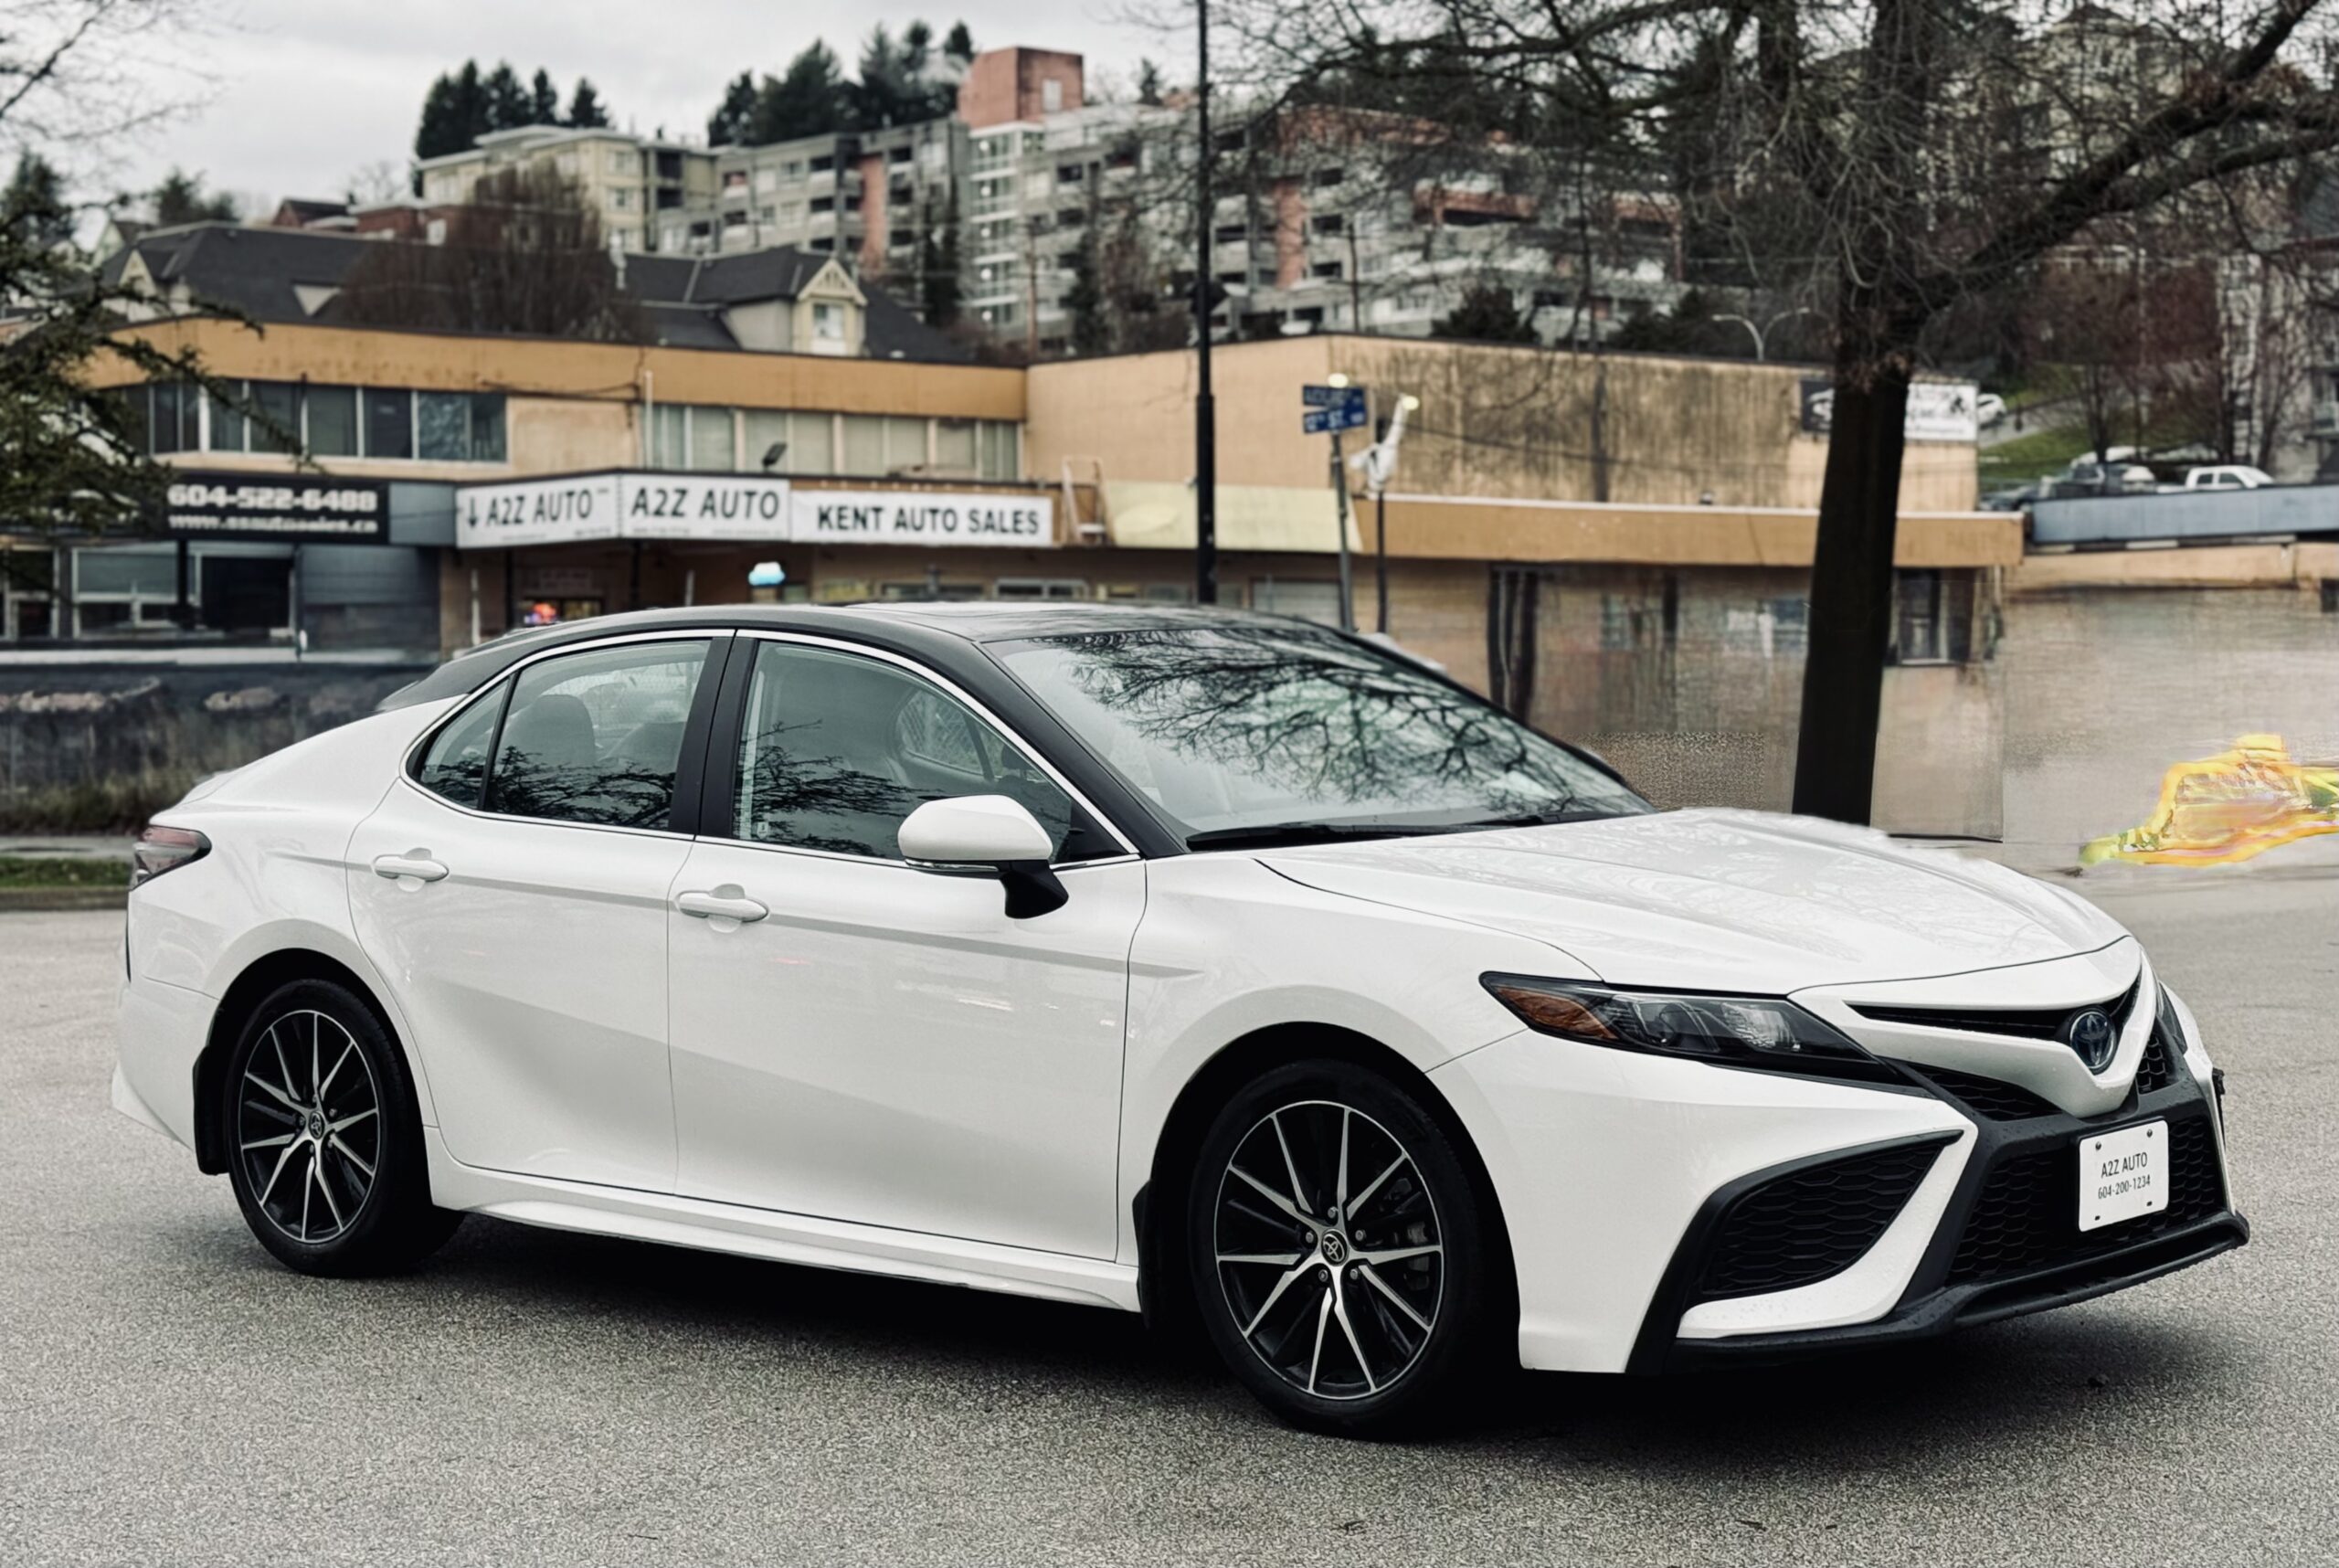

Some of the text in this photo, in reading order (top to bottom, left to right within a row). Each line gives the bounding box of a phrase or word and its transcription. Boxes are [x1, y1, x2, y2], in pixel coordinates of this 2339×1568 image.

[167, 484, 378, 512] 604-522-6488
[486, 489, 593, 527] A2Z AUTO
[631, 488, 781, 520] A2Z AUTO
[818, 505, 1040, 535] KENT AUTO SALES
[2101, 1151, 2147, 1178] A2Z AUTO
[2098, 1174, 2150, 1199] 604-200-1234
